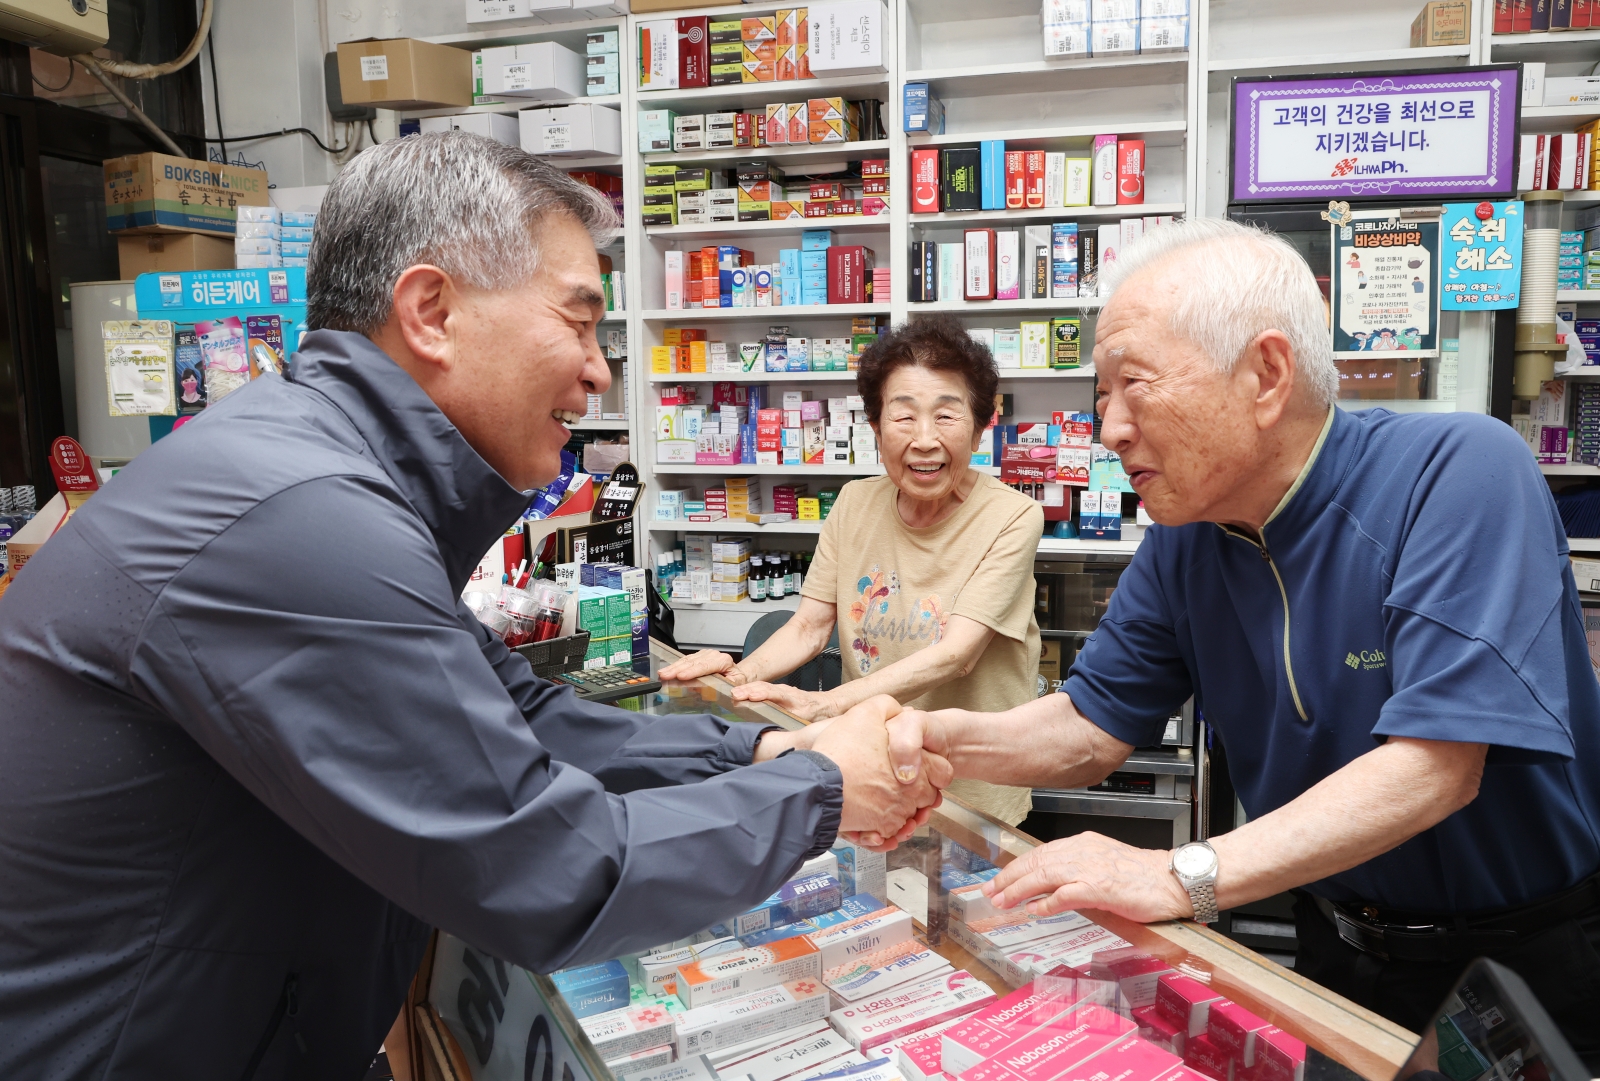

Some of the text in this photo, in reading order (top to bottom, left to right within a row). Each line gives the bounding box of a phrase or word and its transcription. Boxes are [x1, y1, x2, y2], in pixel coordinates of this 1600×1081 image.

[859, 15, 870, 54] 센스데이
[1436, 18, 1462, 27] 수도미터
[1273, 99, 1475, 127] 고객의 건강을 최선으로
[1315, 129, 1430, 153] 지키겠습니다.
[164, 165, 259, 193] BOKSAN NICE
[197, 186, 214, 194] HEALTH
[214, 188, 227, 196] CARE
[1120, 178, 1141, 198] C
[915, 186, 935, 206] C
[1355, 232, 1421, 247] 비상상비약
[1449, 216, 1506, 245] 숙취
[1455, 245, 1513, 271] 해소
[191, 279, 261, 305] 히든케어
[266, 336, 281, 344] 보호대
[855, 995, 892, 1014] 나오덤
[986, 993, 1042, 1025] Nobason
[875, 1016, 901, 1034] 나오덤
[1006, 1023, 1091, 1069] Nobason cream
